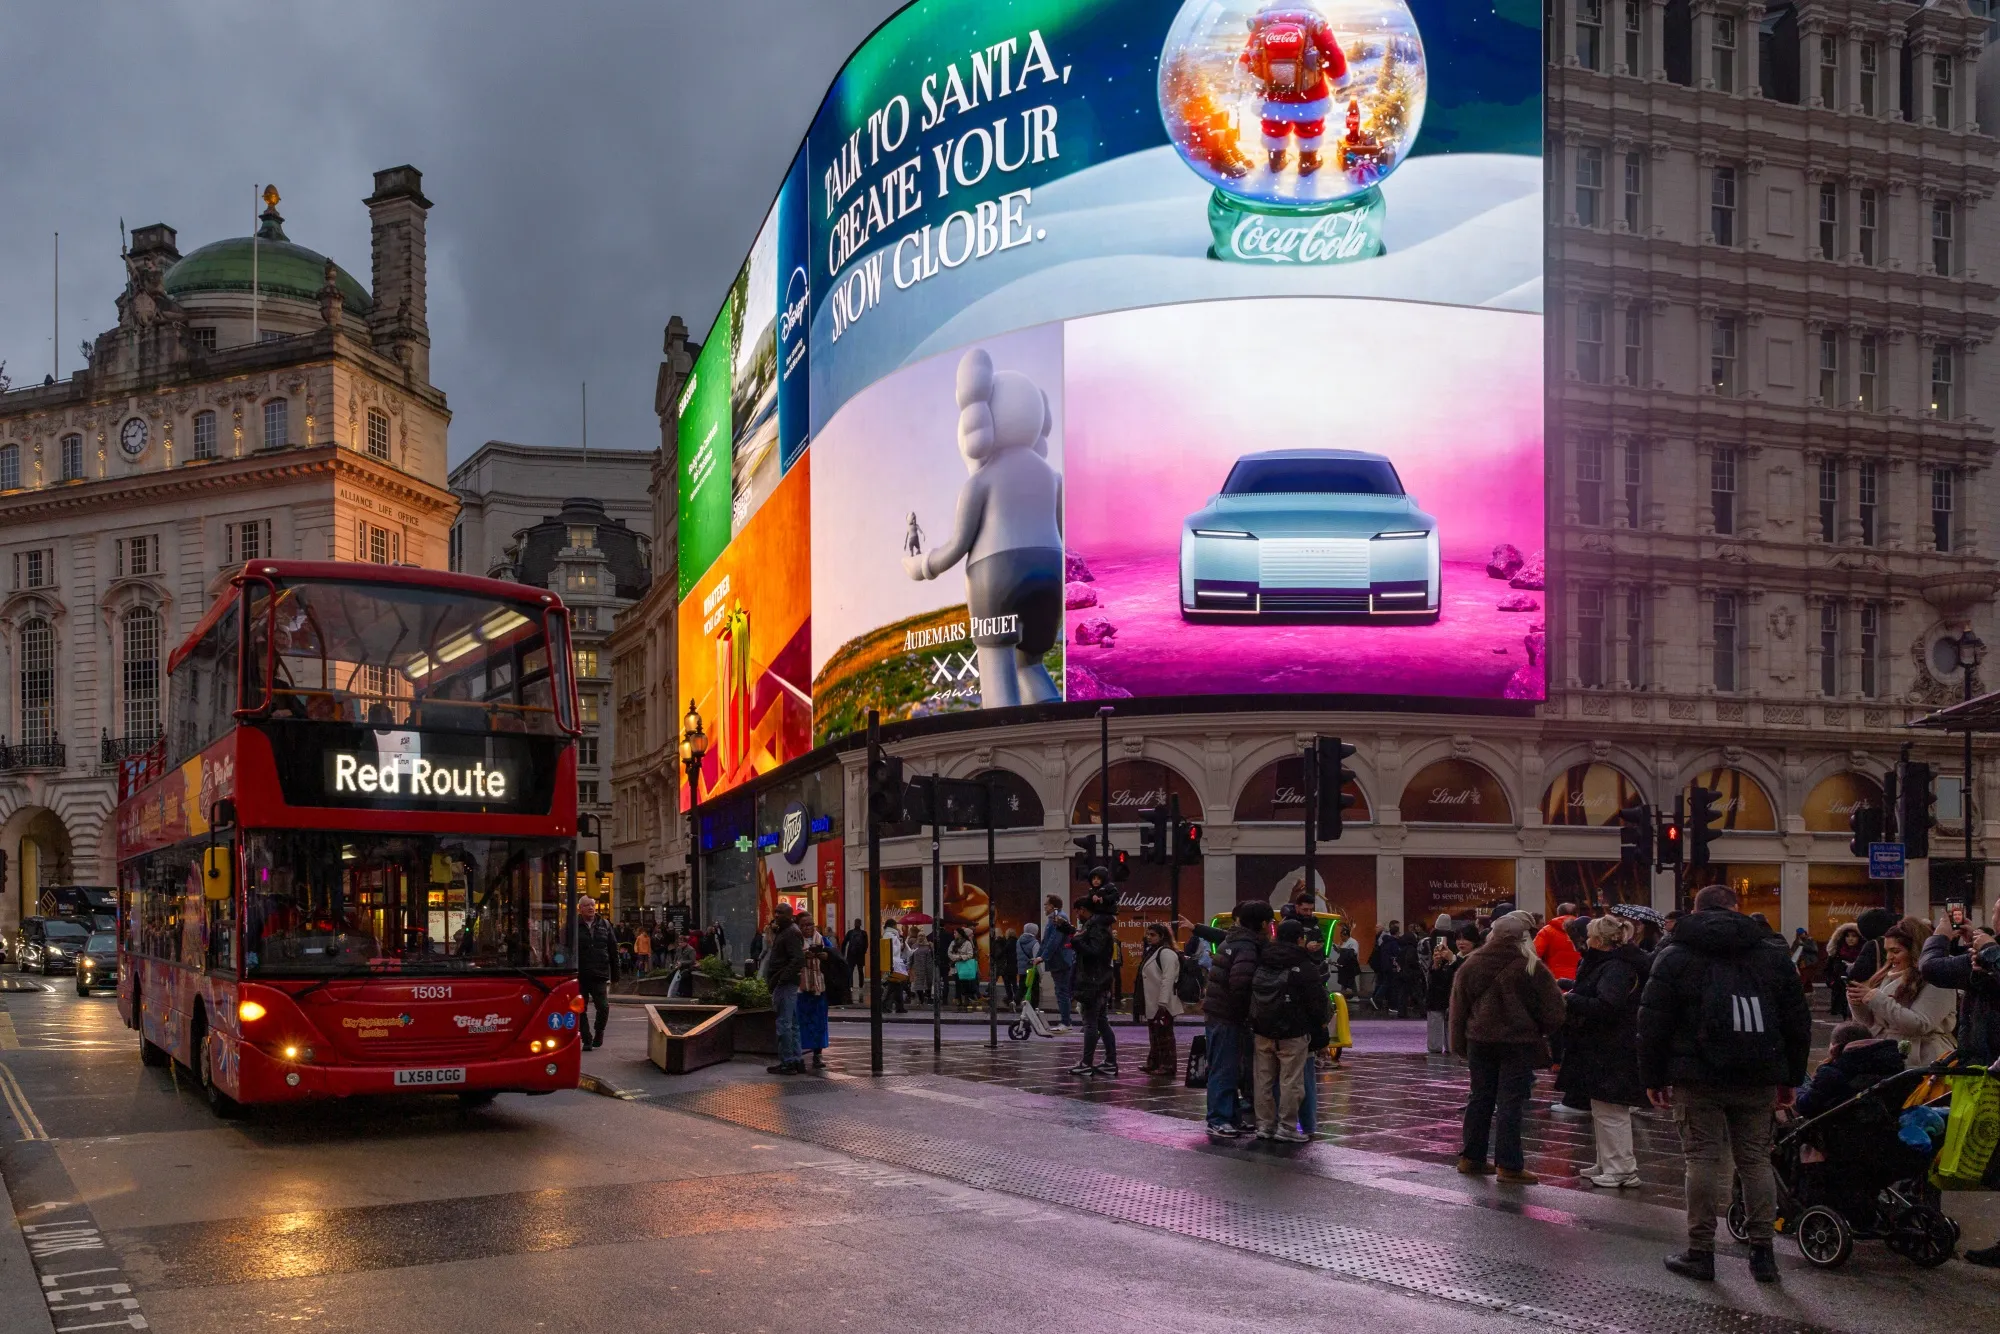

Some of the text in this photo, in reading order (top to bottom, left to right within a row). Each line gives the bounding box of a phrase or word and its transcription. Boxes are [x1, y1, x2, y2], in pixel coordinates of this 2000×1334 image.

[824, 29, 1072, 219] TALK TO SANTA,
[829, 104, 1059, 277] CREATE YOUR
[832, 187, 1047, 344] SNOW GLOBE.
[340, 489, 420, 526] ALLIANCE LIFE OFFICE
[902, 614, 1019, 652] AUDEMARS PIGUET
[336, 754, 506, 798] Red Route
[1107, 789, 1155, 806] Lindt
[1270, 787, 1306, 803] Lin
[1428, 787, 1470, 804] Lindt
[783, 810, 802, 854] Boots
[787, 868, 807, 883] CHANEL
[1429, 879, 1488, 889] We look forward
[1442, 892, 1464, 902] seeing
[1118, 919, 1126, 928] in
[1128, 919, 1141, 928] the
[411, 985, 452, 999] 15031
[453, 1013, 512, 1028] City Tour
[400, 1068, 461, 1083] LX58 CGG
